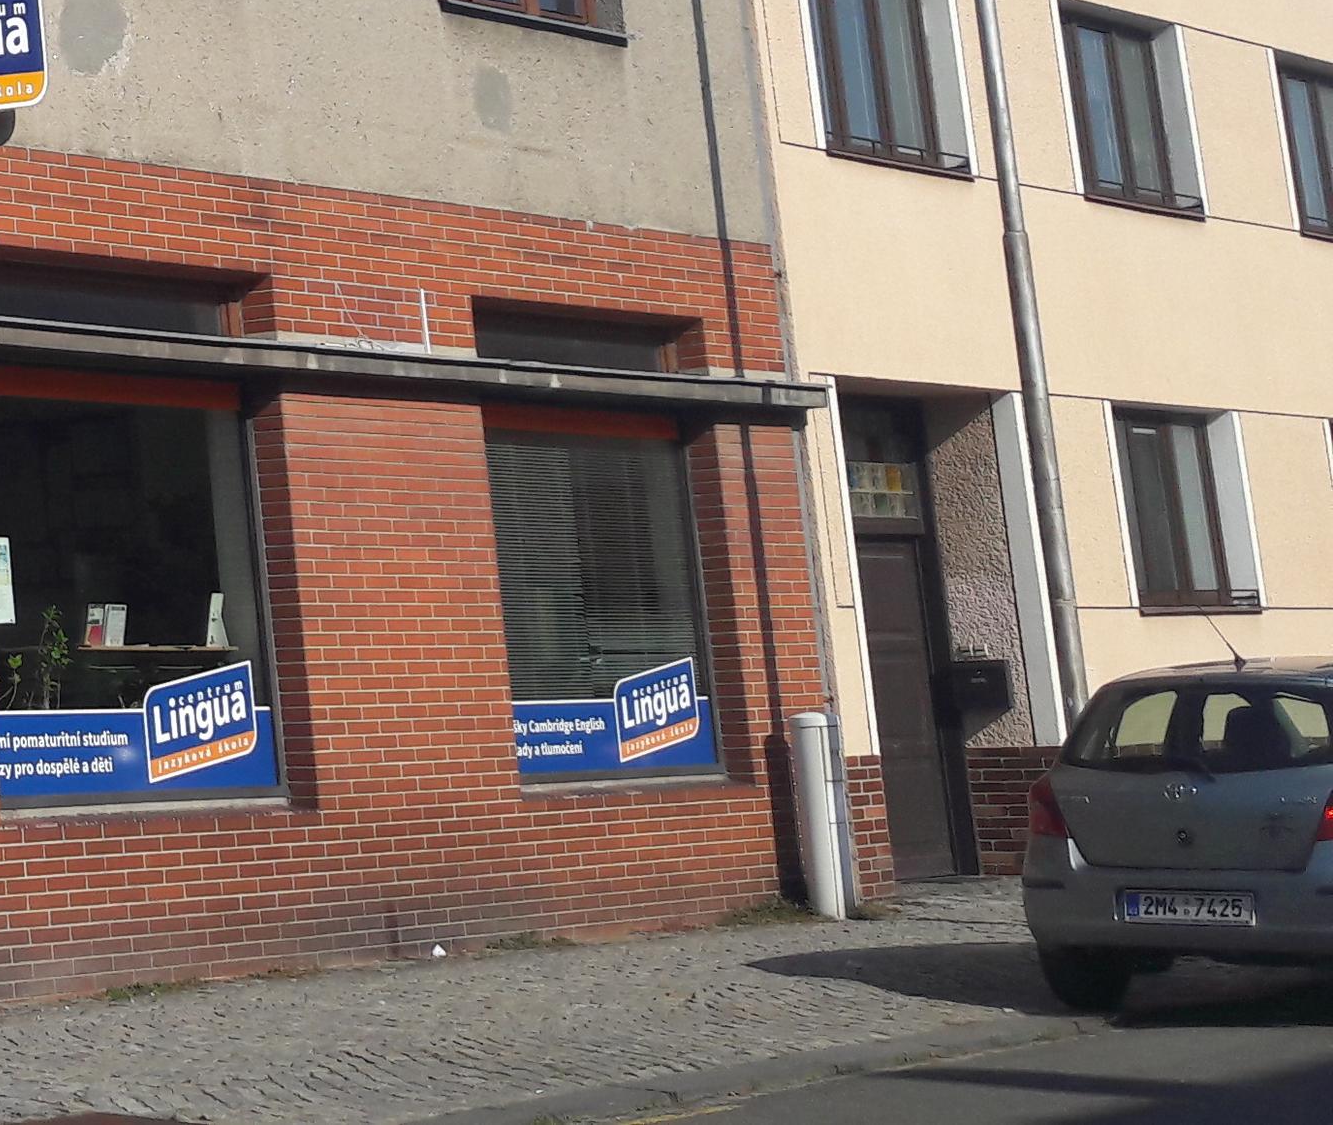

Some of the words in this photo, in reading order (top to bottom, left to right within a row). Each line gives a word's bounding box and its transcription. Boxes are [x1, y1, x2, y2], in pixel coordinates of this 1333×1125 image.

[178, 680, 244, 706] centrum
[153, 691, 247, 744] Lingua
[621, 683, 691, 729] Lingua
[513, 719, 527, 736] šky
[529, 718, 574, 735] Cambridge
[575, 717, 606, 734] English
[13, 730, 81, 752] pomaturitní
[82, 730, 129, 746] studium
[516, 742, 533, 759] ady
[534, 745, 540, 755] a
[158, 746, 212, 773] jazyková
[218, 737, 249, 753] škola
[14, 761, 34, 779] pro
[36, 757, 80, 778] dospělé
[82, 762, 90, 773] a
[91, 756, 113, 773] děti
[1143, 895, 1178, 916] 2M4
[1194, 897, 1243, 917] 7425
